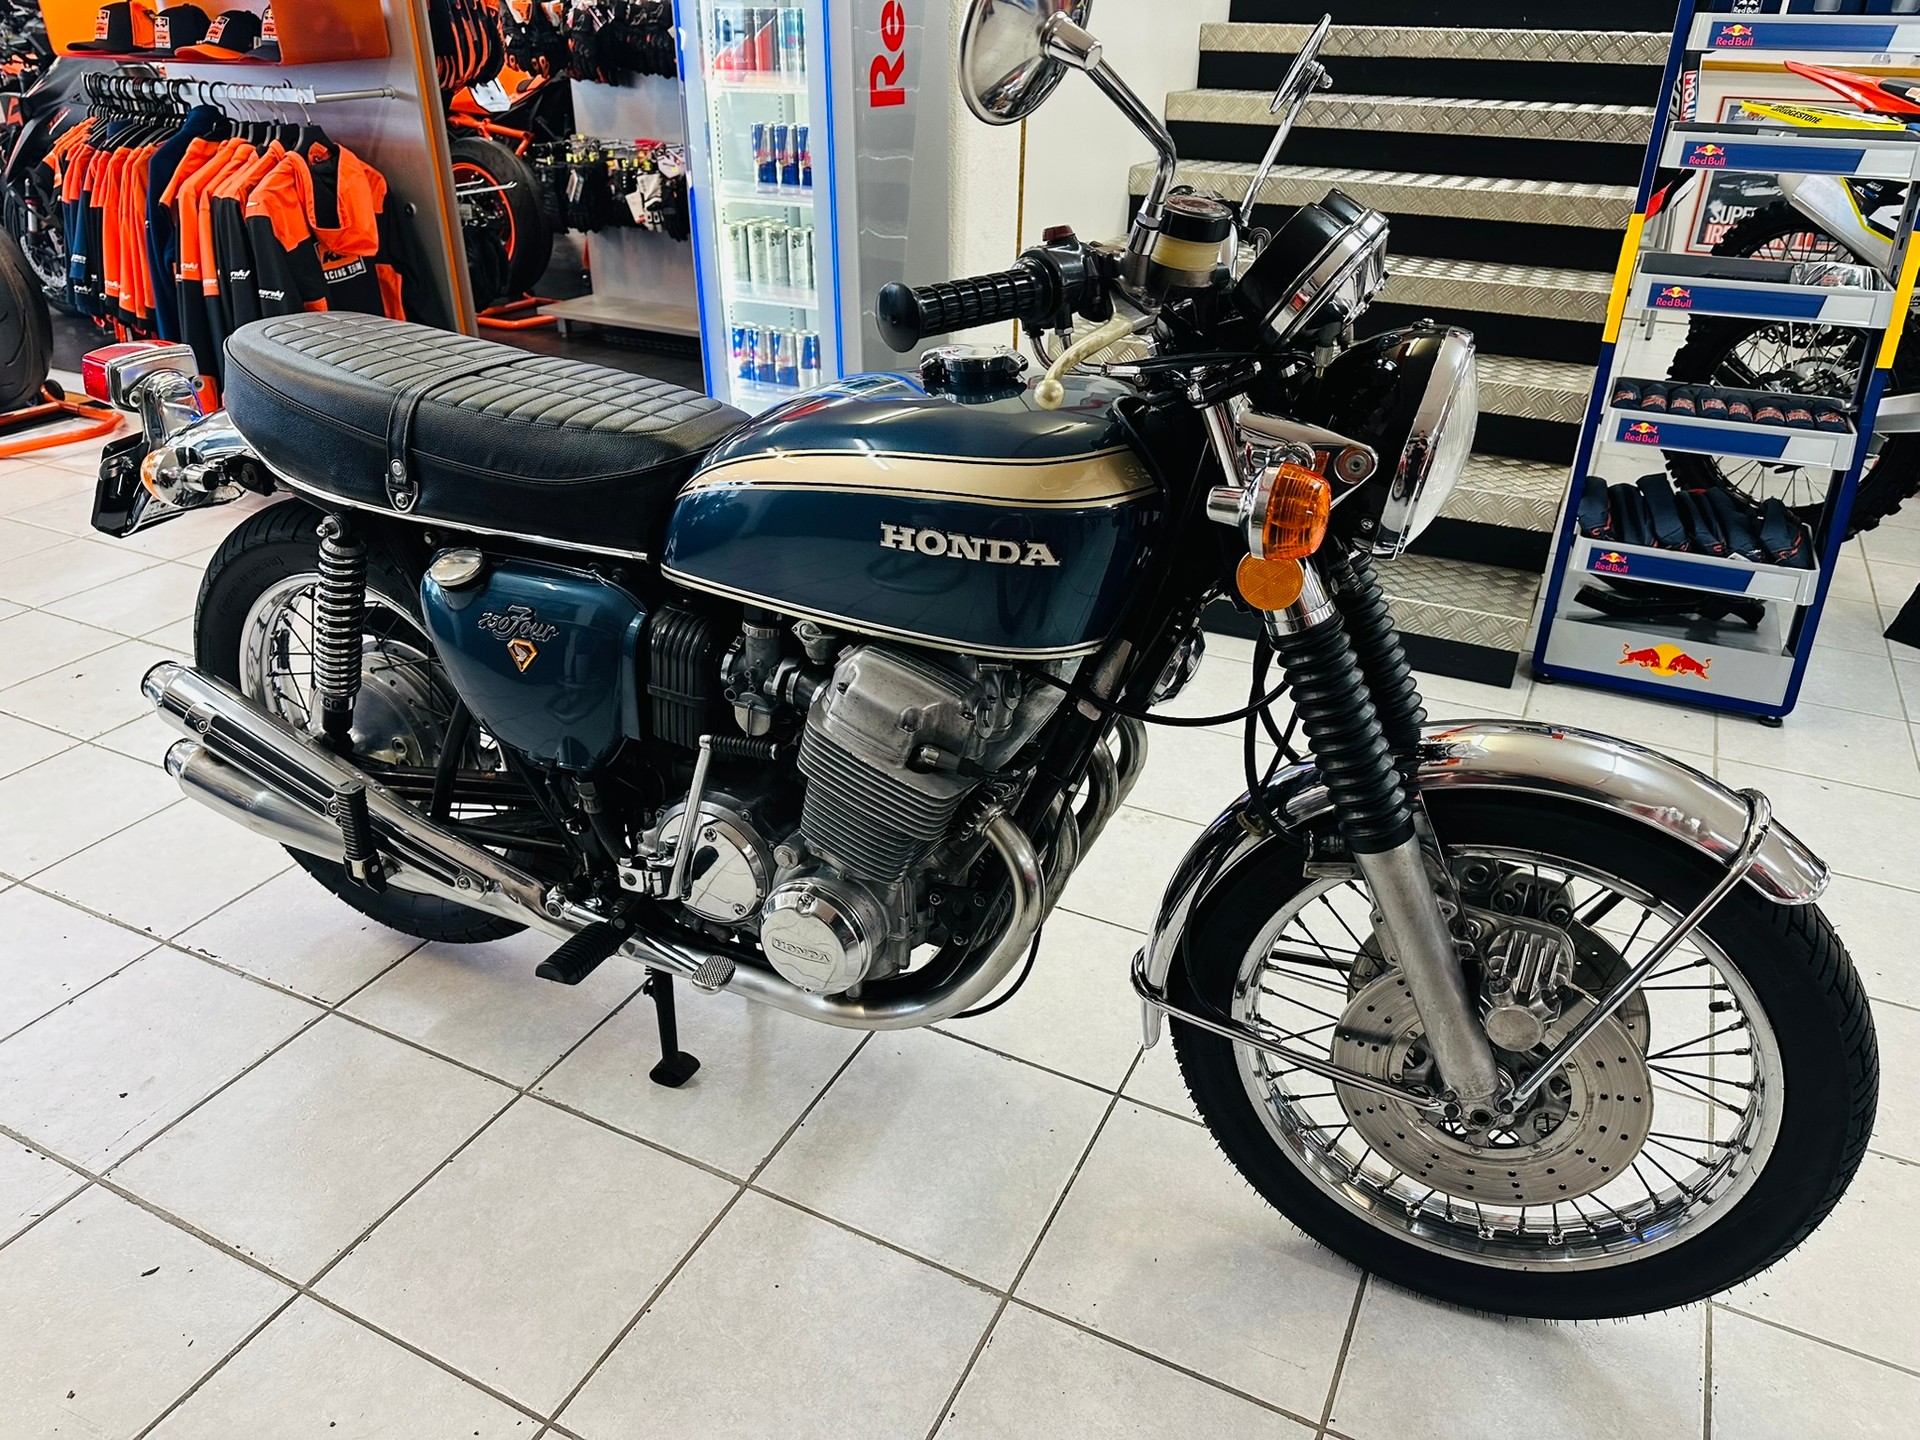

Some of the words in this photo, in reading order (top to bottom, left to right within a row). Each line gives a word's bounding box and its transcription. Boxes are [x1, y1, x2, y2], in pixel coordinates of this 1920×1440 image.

[1716, 37, 1734, 46] Red
[1735, 37, 1754, 47] Bull
[1689, 156, 1707, 165] Red
[1708, 157, 1726, 166] Bull
[1656, 297, 1674, 307] Red
[1674, 299, 1692, 308] Bull
[1624, 432, 1641, 442] Red
[1642, 434, 1659, 444] Bull
[880, 521, 1061, 567] HONDA
[1595, 561, 1611, 571] Red
[1612, 563, 1629, 573] Bull
[773, 938, 831, 962] HONDA
